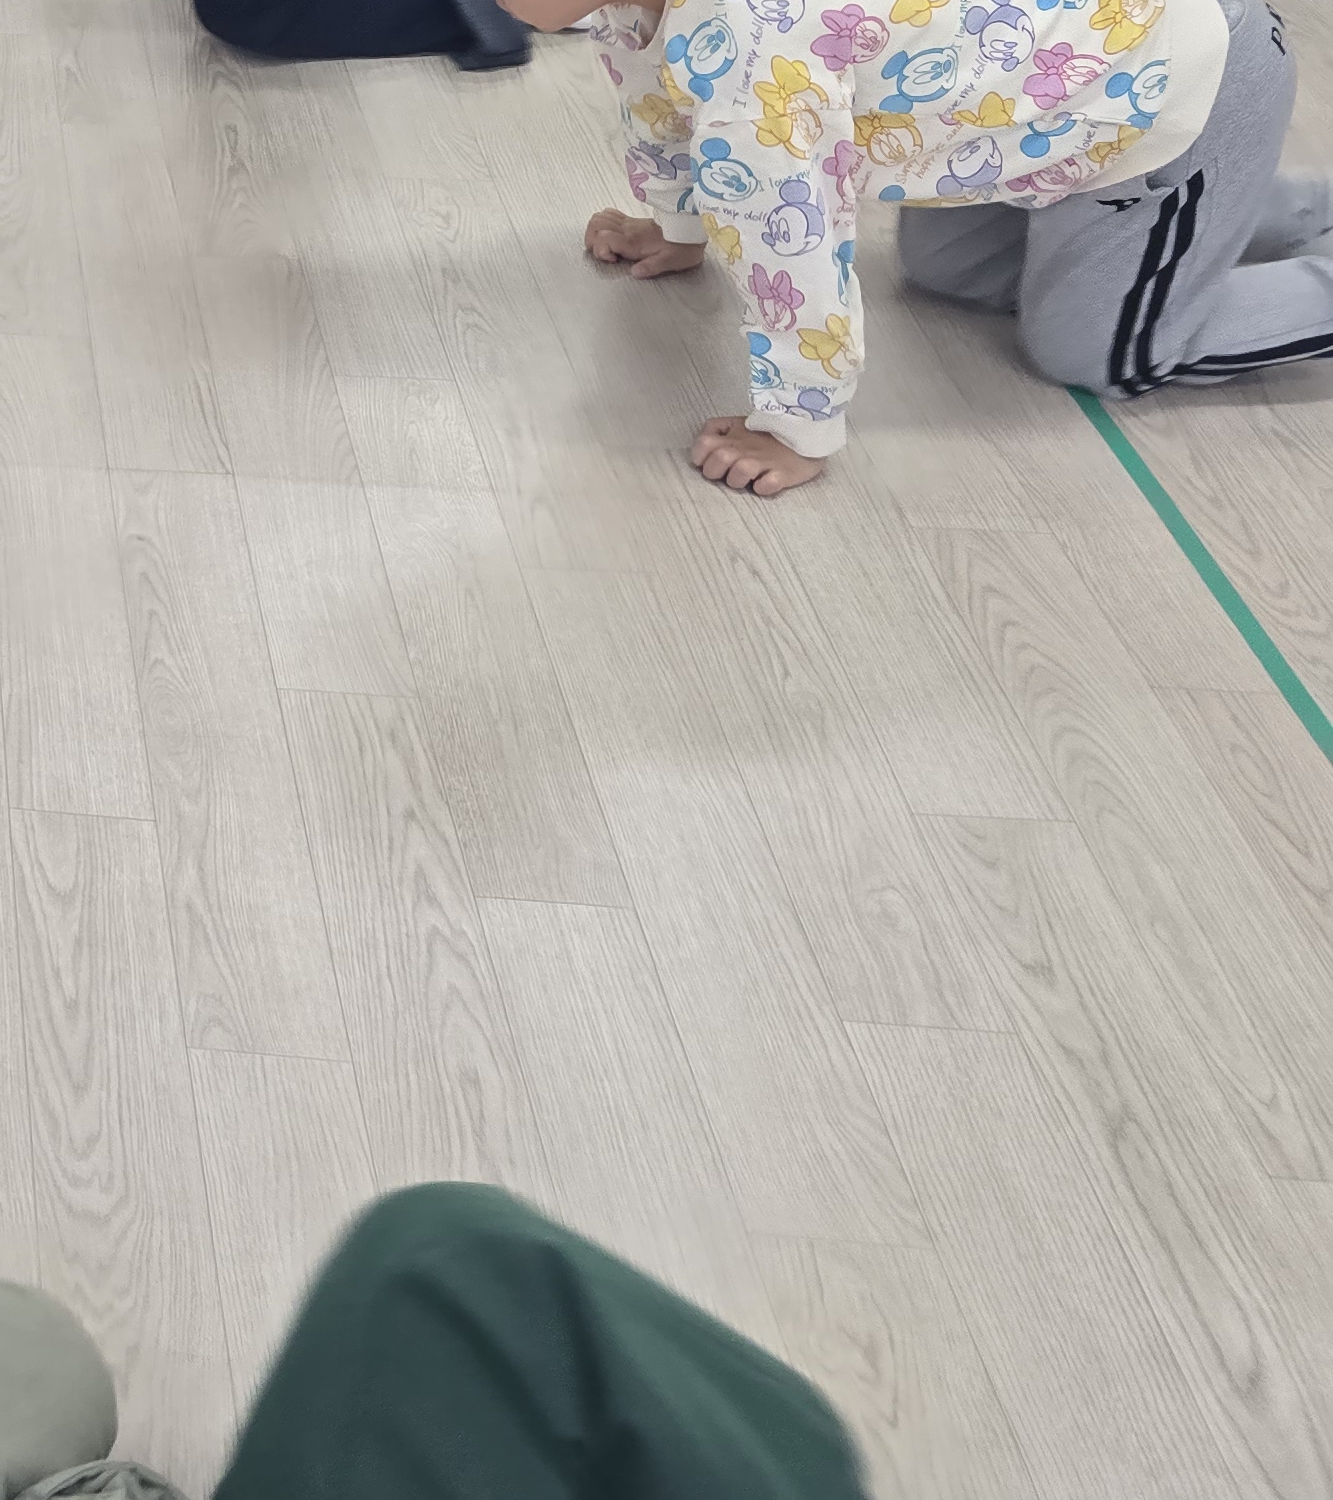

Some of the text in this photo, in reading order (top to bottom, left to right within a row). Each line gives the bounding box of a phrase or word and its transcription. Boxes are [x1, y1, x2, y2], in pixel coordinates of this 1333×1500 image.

[745, 49, 761, 68] my
[971, 53, 994, 80] doll
[735, 69, 753, 95] love
[731, 97, 747, 109] I
